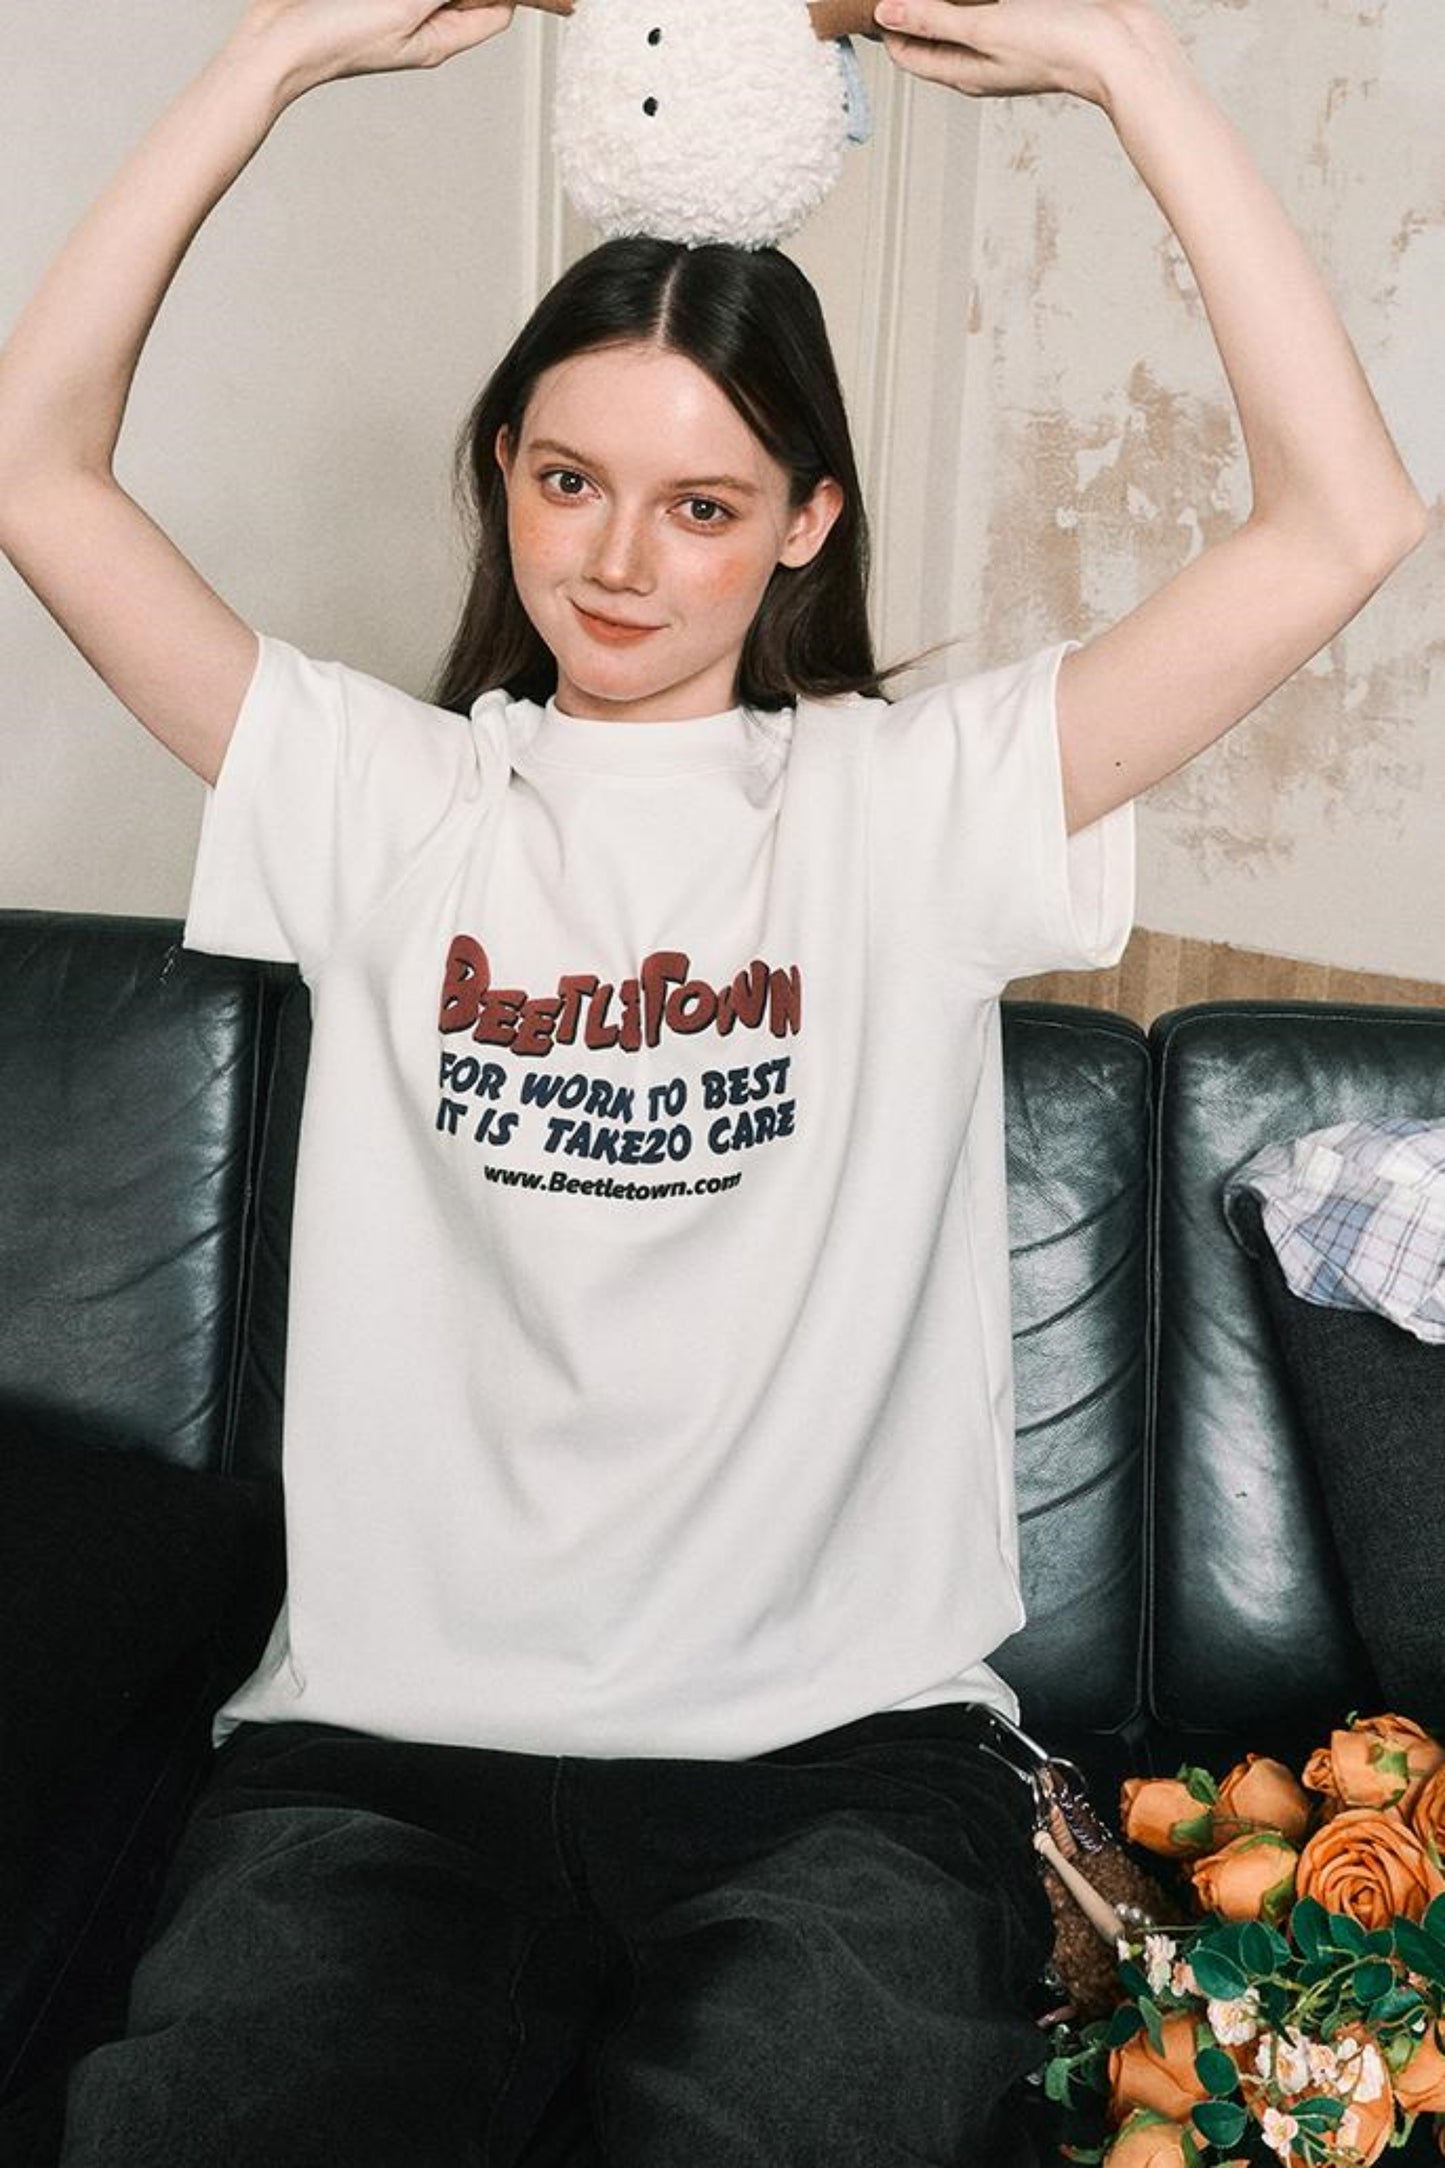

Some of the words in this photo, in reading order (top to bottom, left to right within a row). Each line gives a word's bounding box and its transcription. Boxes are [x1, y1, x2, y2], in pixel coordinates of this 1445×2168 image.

[439, 1051, 507, 1101] FOR
[521, 1072, 635, 1123] WORK
[648, 1078, 687, 1121] TO
[701, 1056, 792, 1110] BEST
[436, 1097, 467, 1136] IT
[474, 1108, 519, 1146] IS
[707, 1100, 796, 1155] CARE
[483, 1164, 742, 1201] www.Beetletown.com
